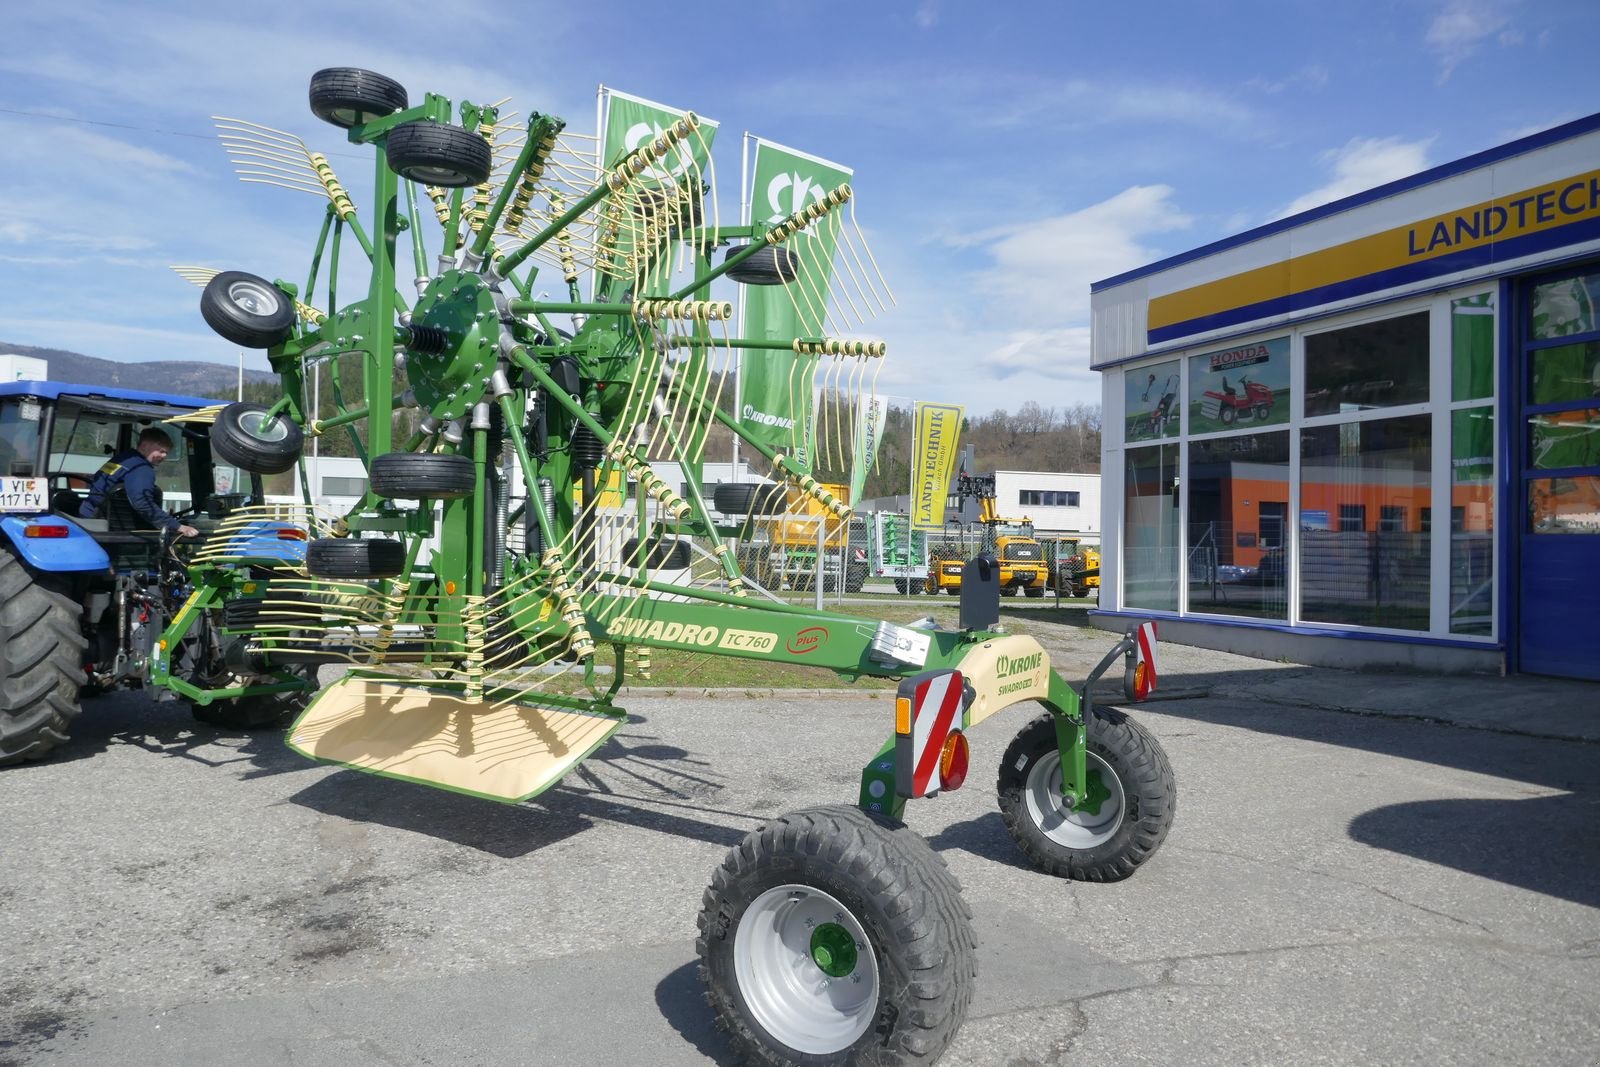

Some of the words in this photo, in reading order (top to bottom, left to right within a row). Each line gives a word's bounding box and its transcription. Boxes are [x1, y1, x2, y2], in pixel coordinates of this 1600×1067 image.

[1209, 346, 1270, 366] HONDA
[920, 410, 944, 523] LANDTECHNIK
[12, 480, 25, 492] VI
[606, 616, 719, 646] SWADRO
[726, 633, 744, 645] TC
[747, 636, 771, 649] 760
[1009, 652, 1042, 676] KRONE
